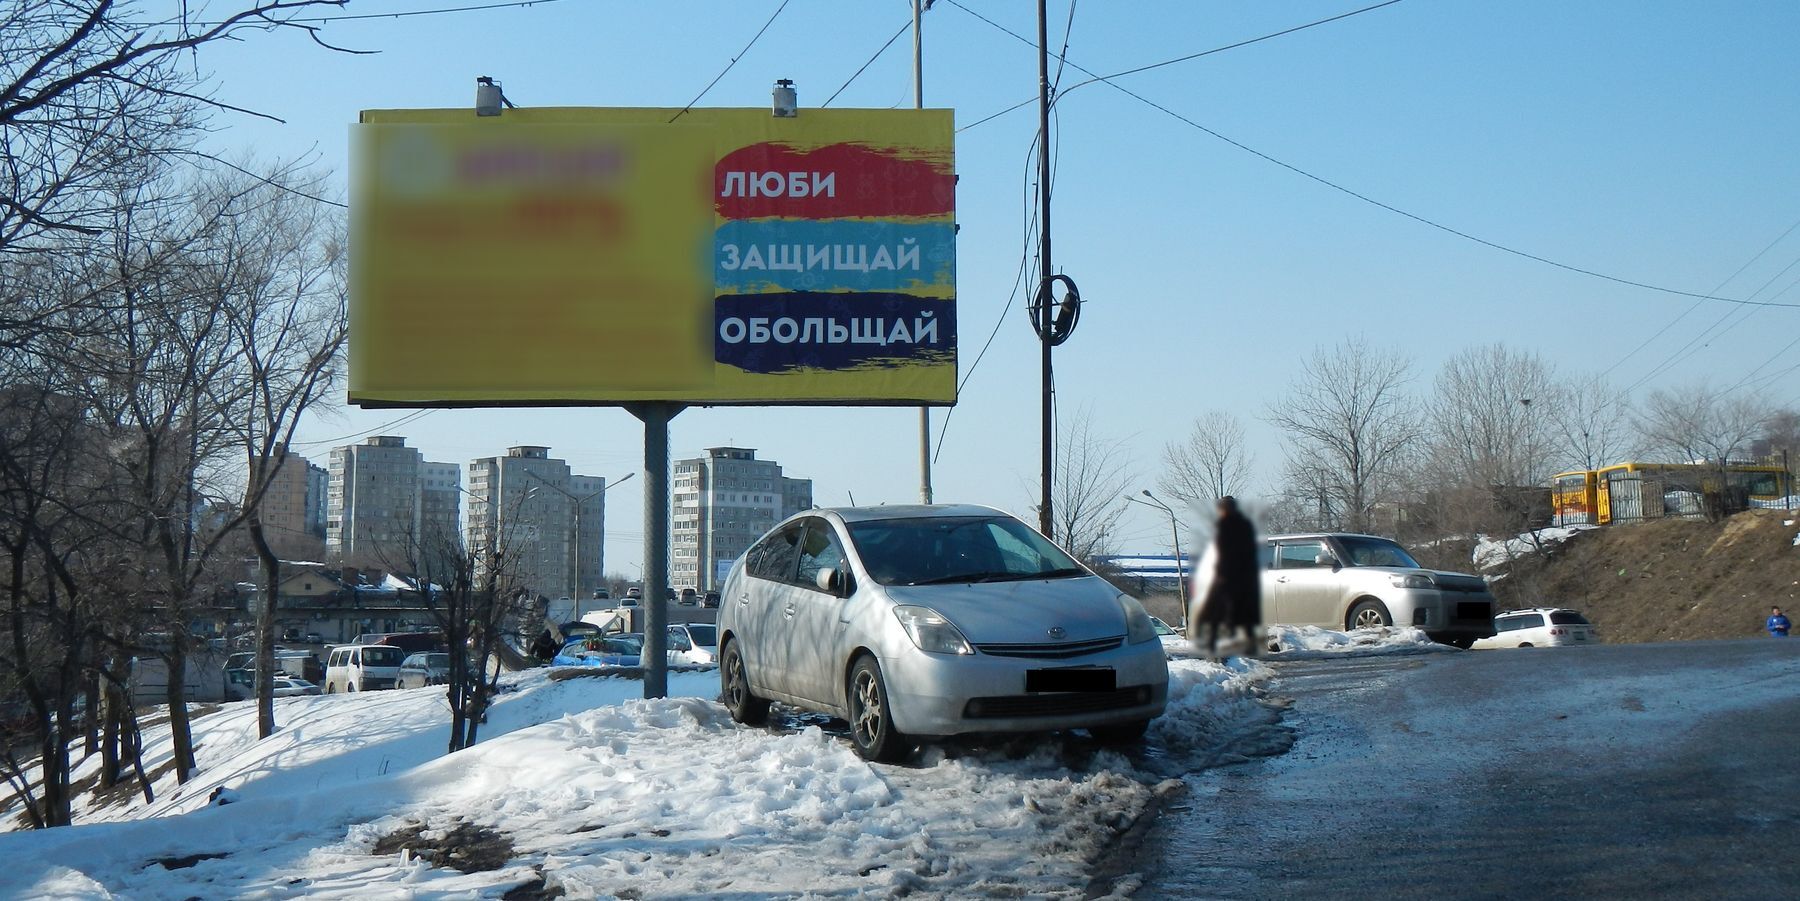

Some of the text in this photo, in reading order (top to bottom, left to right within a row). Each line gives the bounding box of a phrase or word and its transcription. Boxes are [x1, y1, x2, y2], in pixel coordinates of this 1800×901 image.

[721, 171, 836, 198] ЛЮБИ
[720, 237, 920, 273] ЗАЩИЩАЙ
[719, 310, 938, 346] ОБОЛЬЩАЙ
